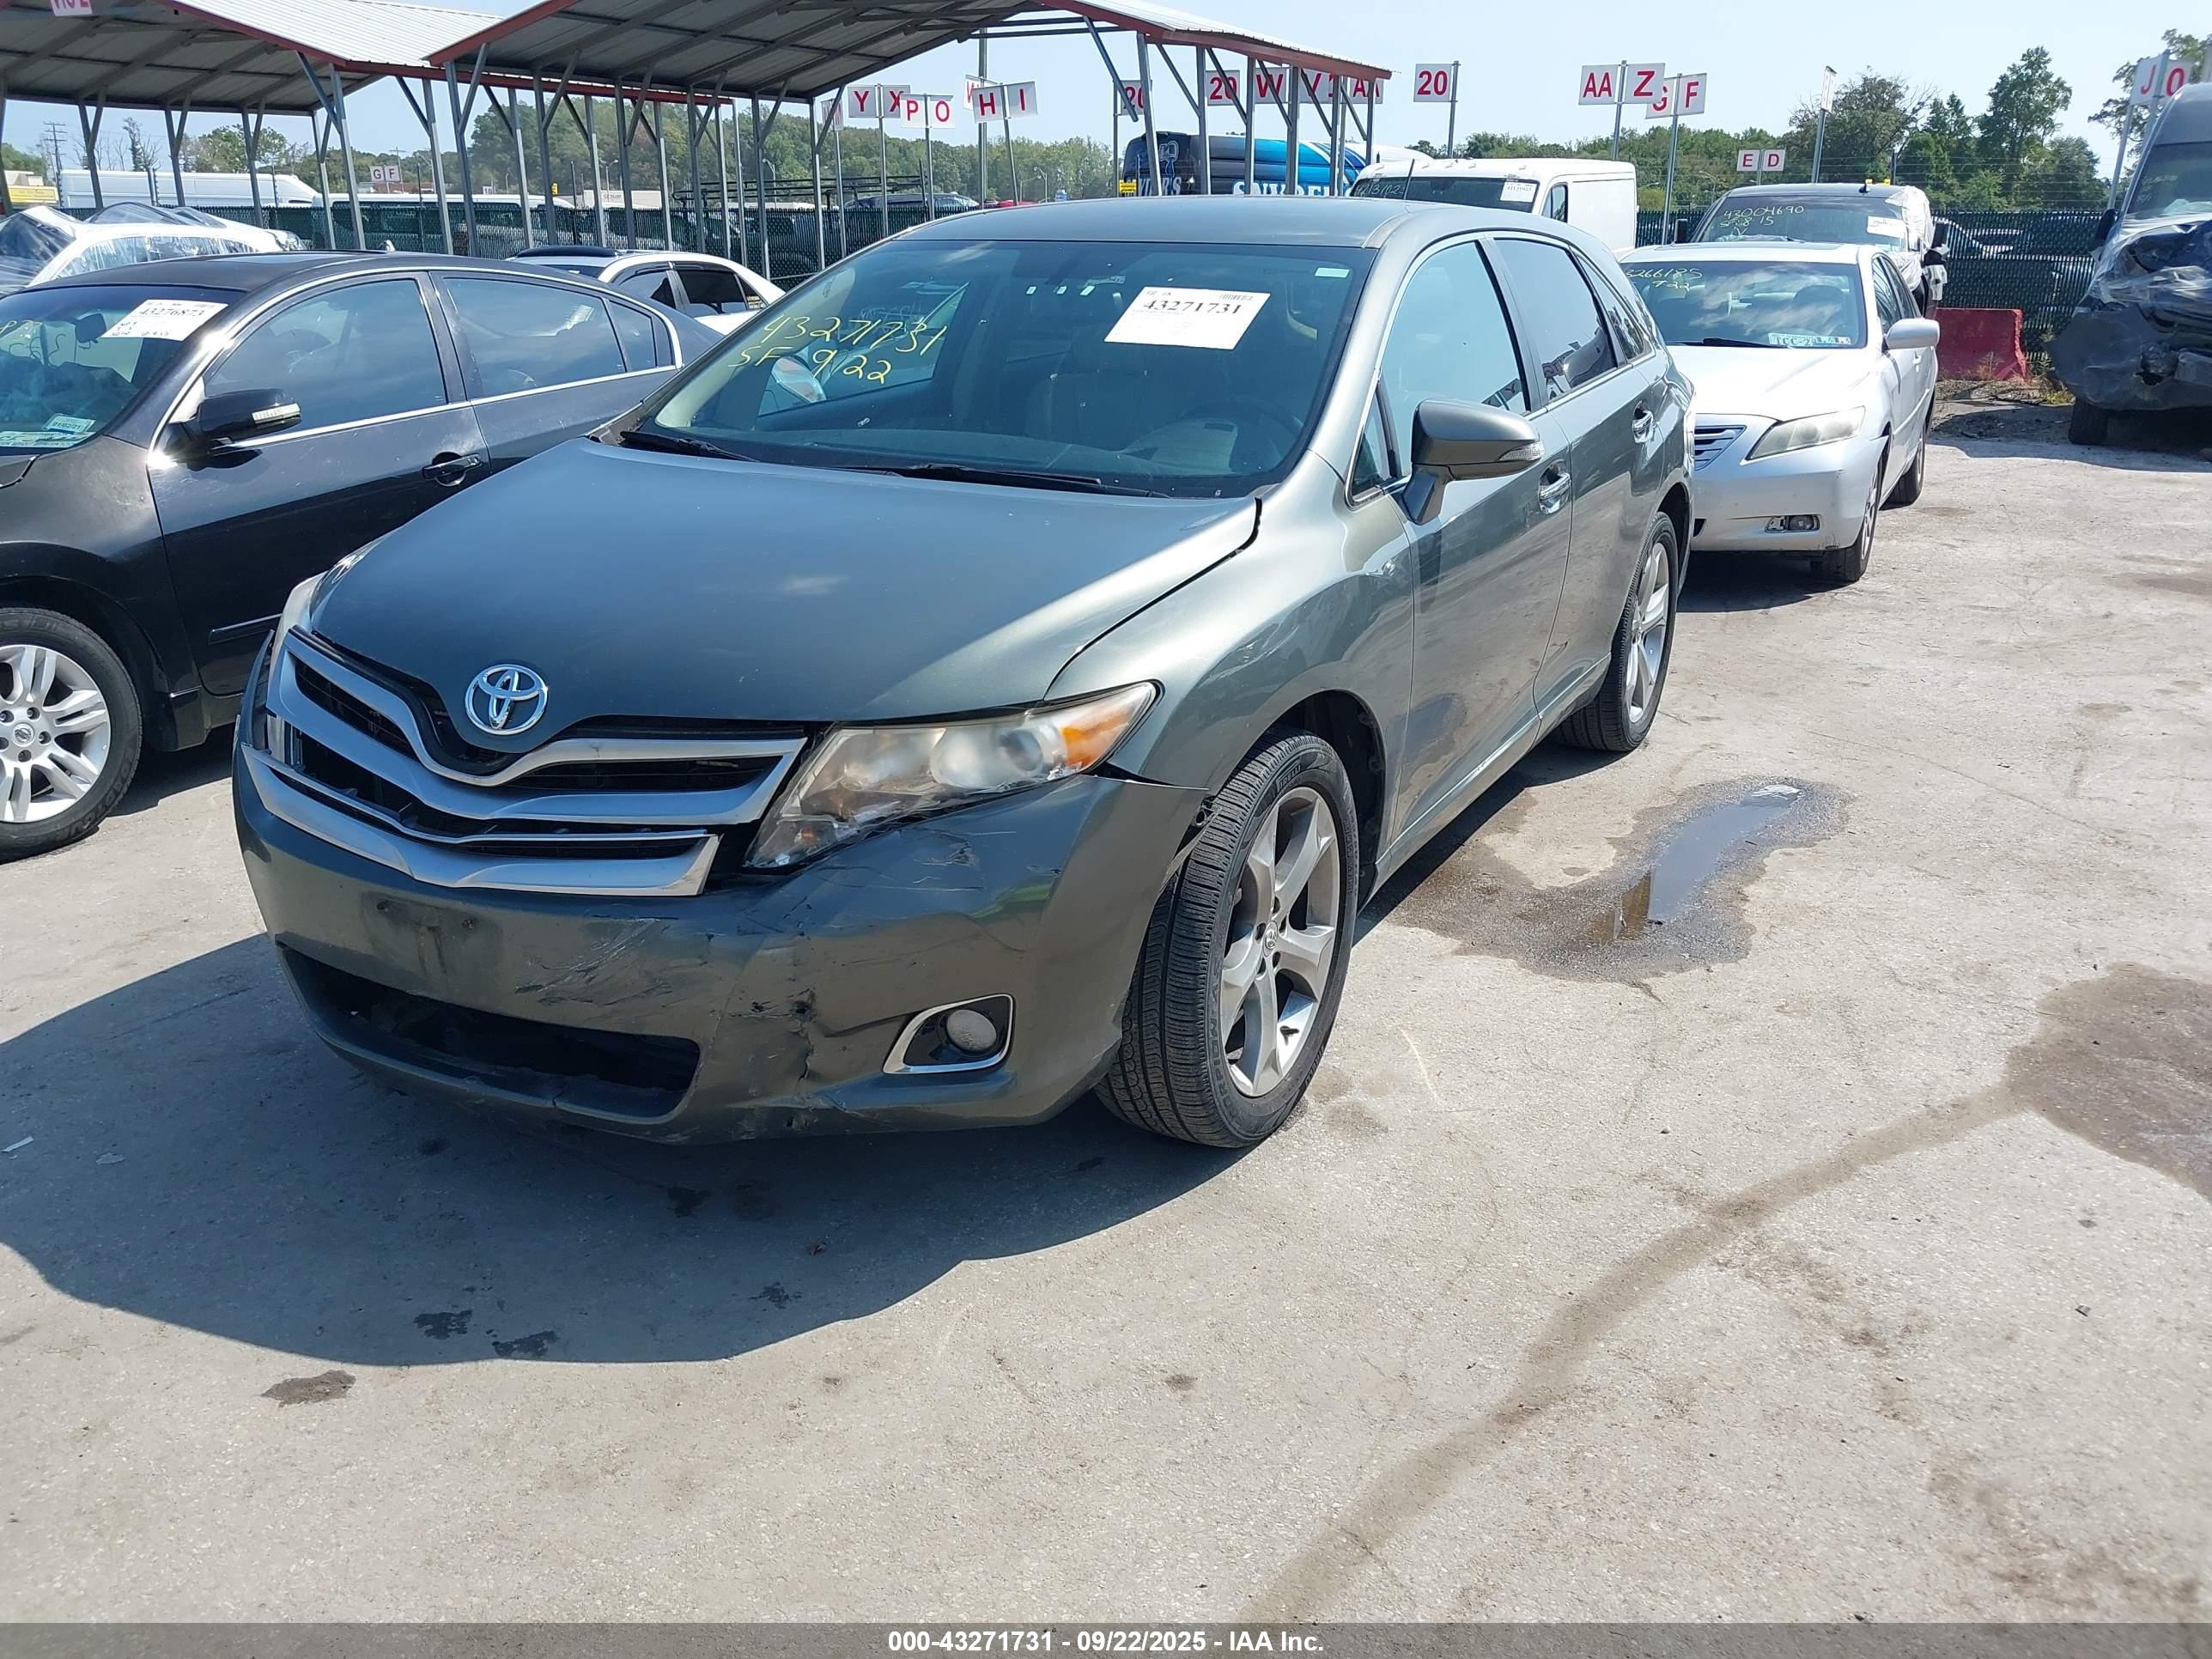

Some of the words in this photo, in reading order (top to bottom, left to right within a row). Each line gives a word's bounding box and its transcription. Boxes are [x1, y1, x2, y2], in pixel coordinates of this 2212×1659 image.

[1210, 77, 1237, 100] 20
[1256, 74, 1283, 98] W
[1417, 70, 1449, 95] 20
[1583, 72, 1612, 97] AA
[1633, 71, 1655, 96] Z
[2141, 64, 2156, 94] J
[2166, 68, 2185, 96] O
[854, 91, 869, 112] Y
[890, 91, 903, 112] X
[979, 92, 995, 116] H
[1018, 88, 1025, 111] I
[1685, 82, 1699, 107] F
[907, 100, 919, 121] P
[935, 100, 950, 122] O
[1742, 154, 1753, 167] E
[1767, 154, 1779, 167] D
[373, 168, 381, 179] G
[390, 168, 395, 179] F
[1723, 205, 1804, 219] 43004690
[1143, 300, 1243, 314] 43271731
[762, 315, 947, 356] 43271731
[728, 345, 793, 368] SF
[812, 349, 837, 379] 9
[842, 356, 892, 385] 22
